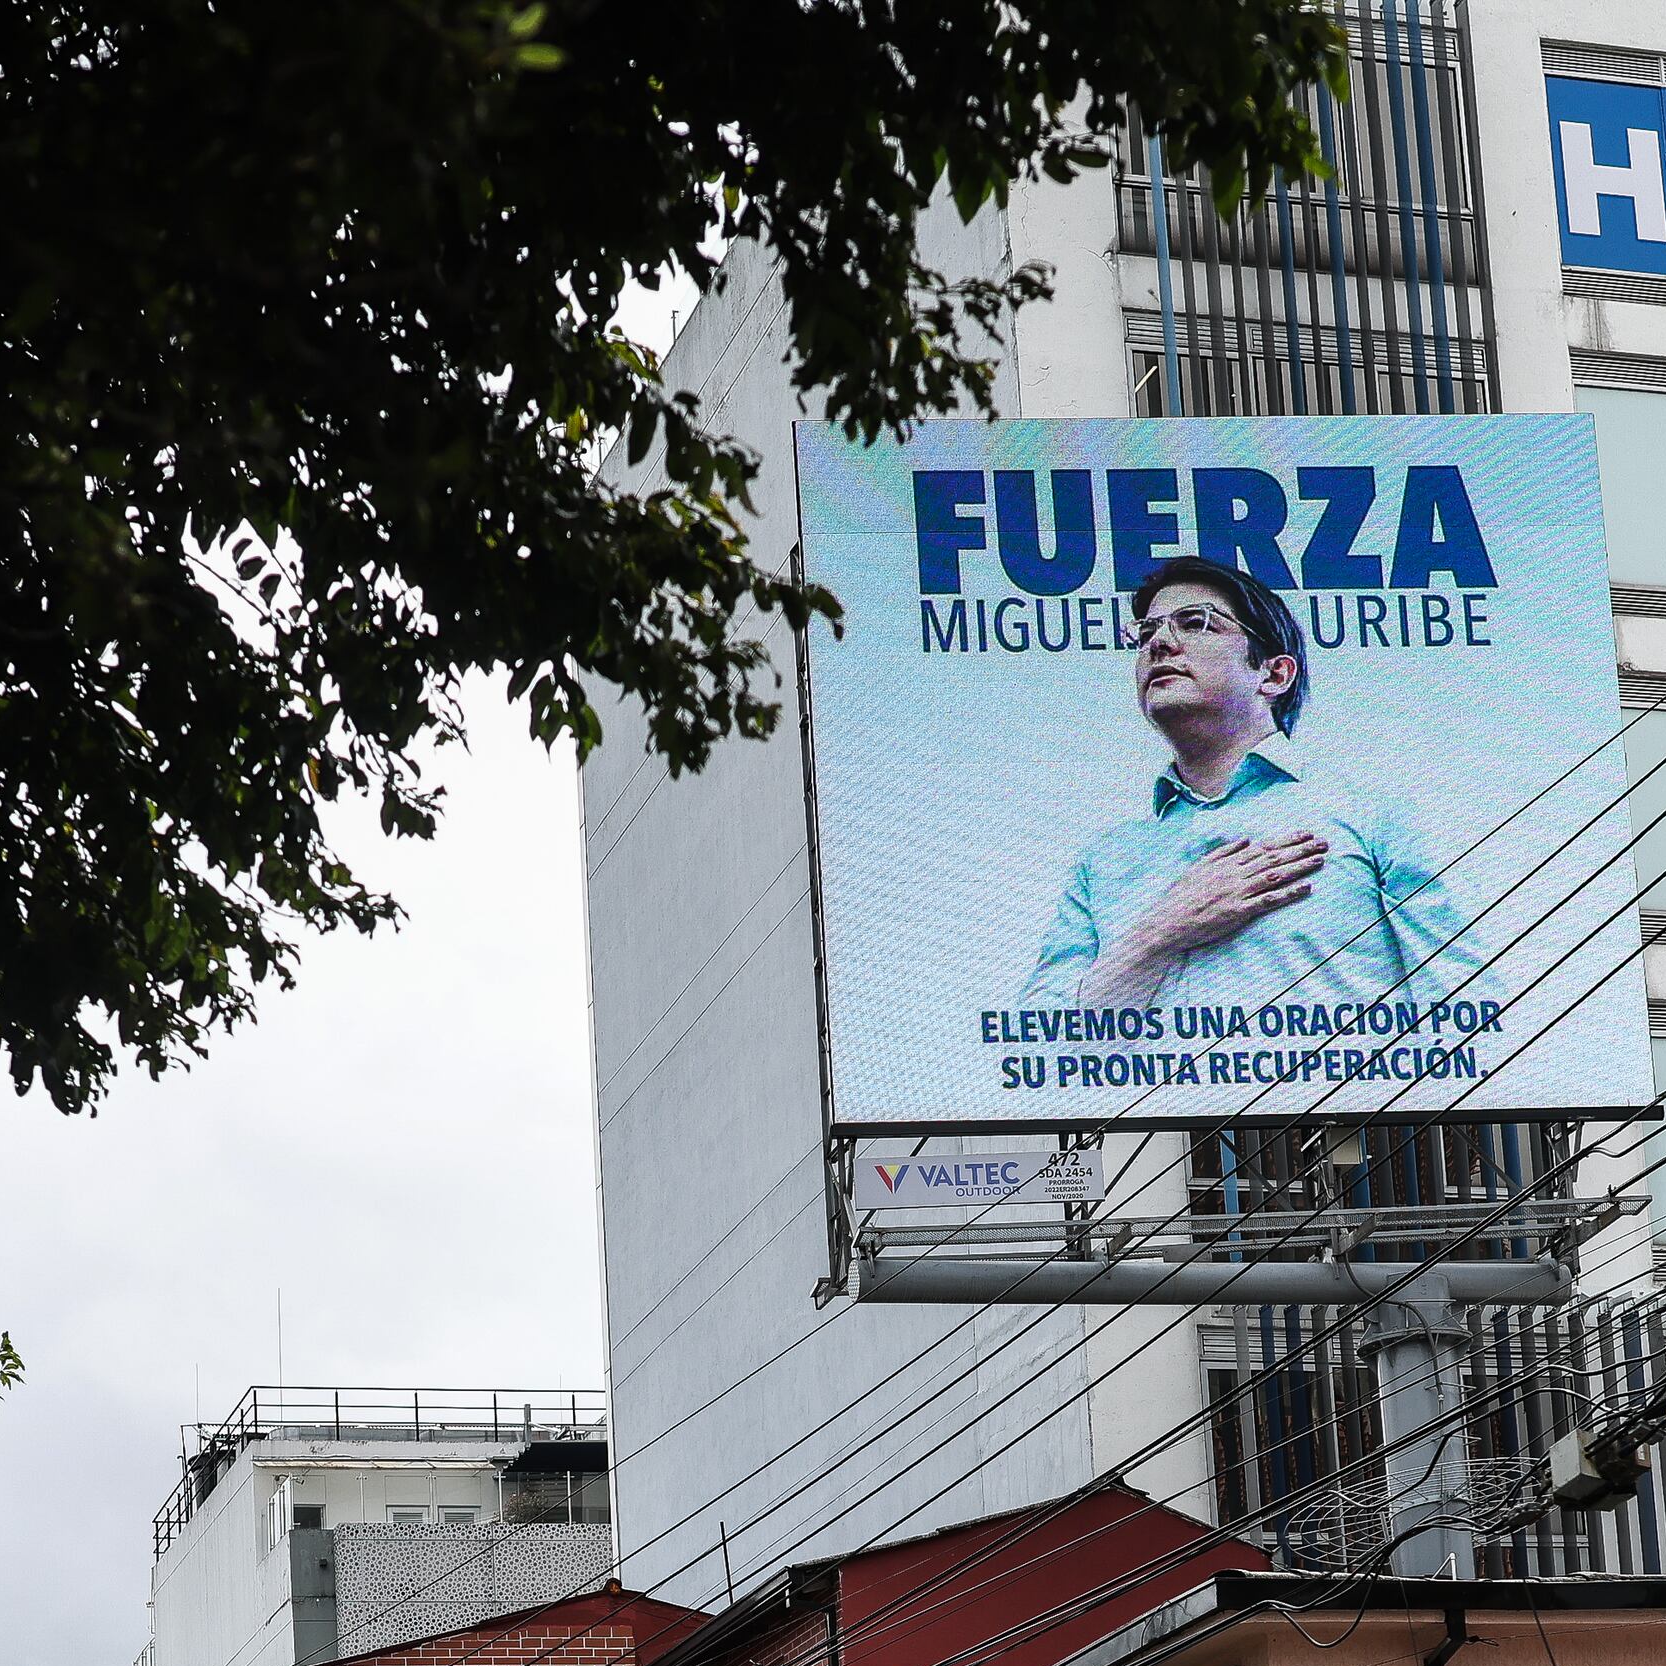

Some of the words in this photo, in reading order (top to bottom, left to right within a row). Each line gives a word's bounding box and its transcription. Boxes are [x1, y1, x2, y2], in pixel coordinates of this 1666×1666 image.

[912, 465, 1499, 596] FUERZA
[920, 596, 1135, 654] MIGUEL
[1309, 594, 1492, 649] URIBE
[981, 1006, 1164, 1043] ELEVEMOS
[1175, 1006, 1251, 1039] UNA
[1259, 996, 1420, 1037] ORACIÓN
[1433, 1000, 1503, 1034] POR
[1002, 1055, 1045, 1089] SU
[1058, 1053, 1199, 1088] PRONTA
[917, 1161, 1021, 1188] VALTEC
[1038, 1168, 1062, 1178] SDA
[1065, 1167, 1093, 1177] 2454
[1048, 1152, 1081, 1167] 472
[955, 1185, 1022, 1197] OUTDOOR
